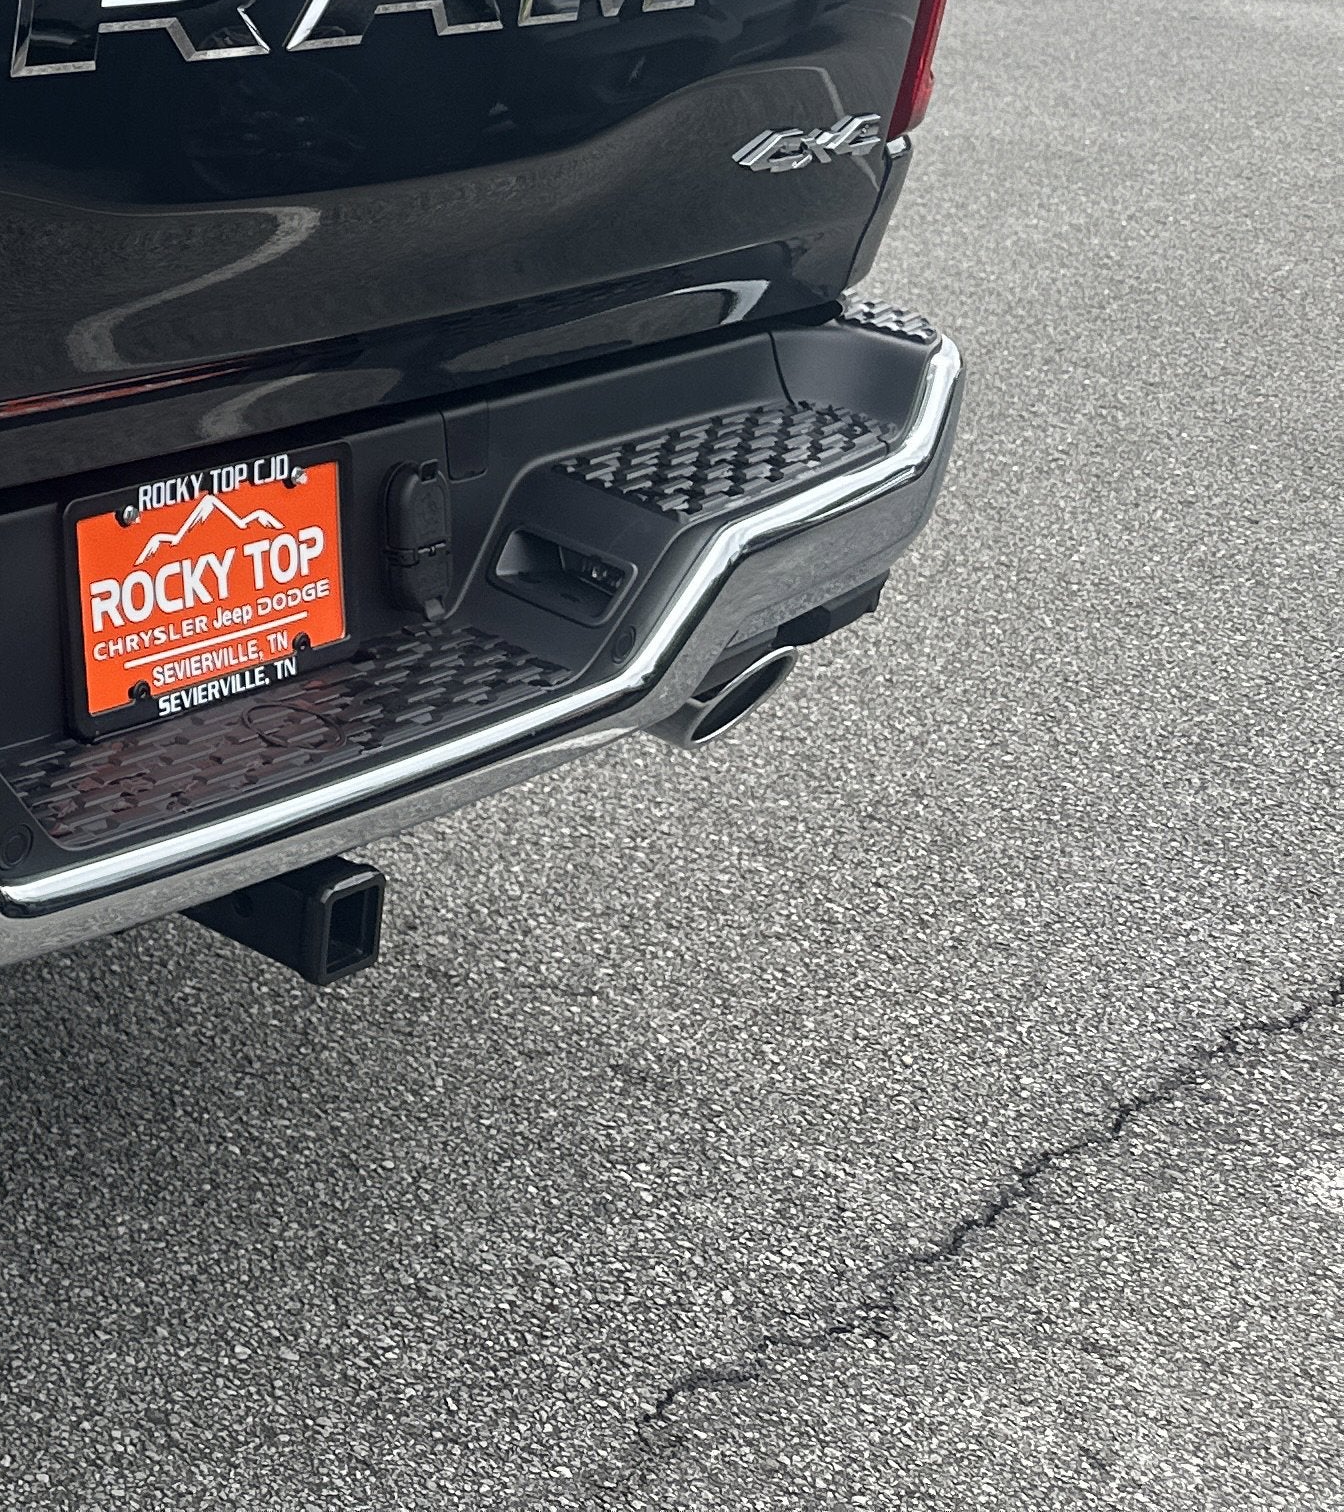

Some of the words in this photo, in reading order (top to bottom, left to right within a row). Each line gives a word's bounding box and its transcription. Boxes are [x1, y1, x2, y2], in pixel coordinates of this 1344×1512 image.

[139, 472, 205, 511] ROCKY
[210, 463, 248, 495] TOP
[253, 454, 289, 485] CJD
[89, 546, 237, 633] ROCKY
[243, 525, 325, 590] TOP
[93, 616, 209, 661] CHRYSLER
[212, 604, 252, 629] Jeep
[256, 578, 331, 616] DODGE
[151, 638, 264, 688] SEVIERVILLE,
[268, 631, 289, 653] TN
[273, 657, 298, 681] TN
